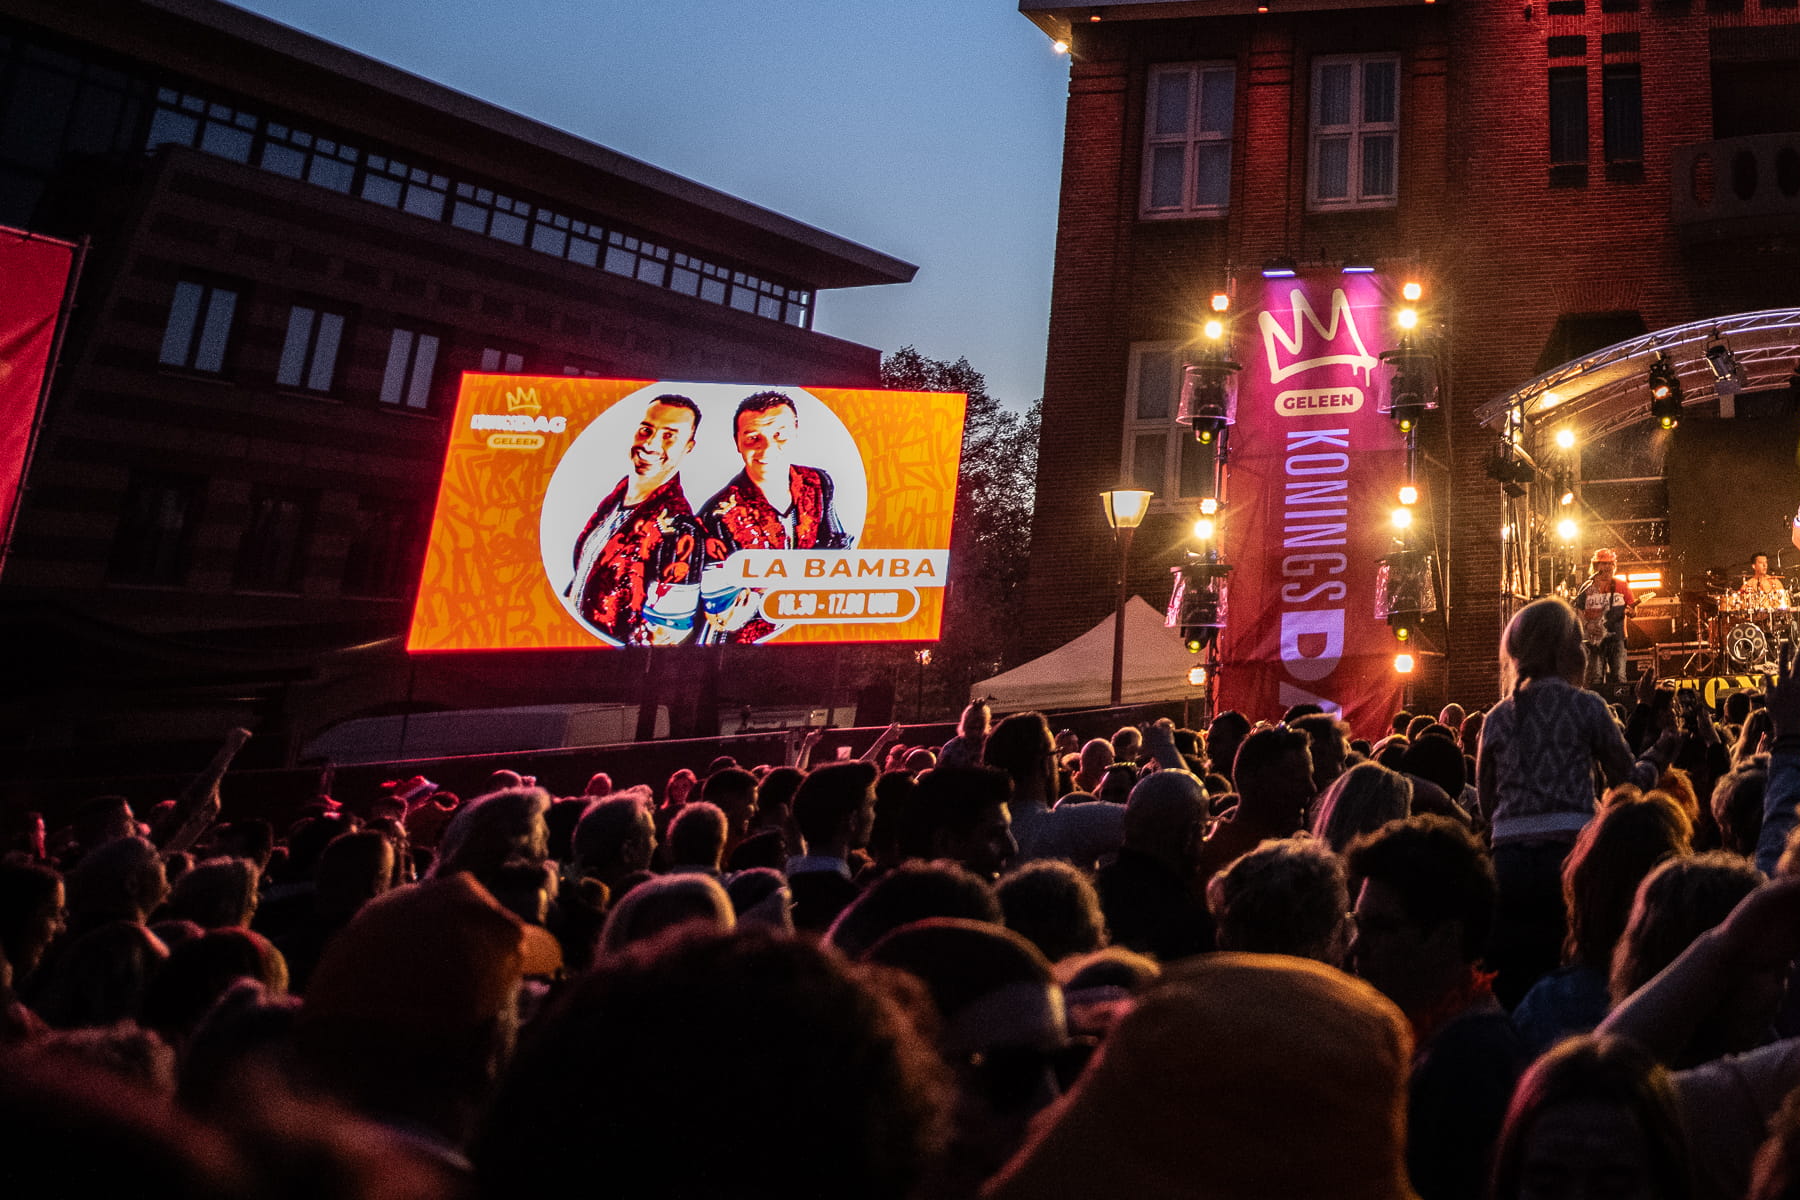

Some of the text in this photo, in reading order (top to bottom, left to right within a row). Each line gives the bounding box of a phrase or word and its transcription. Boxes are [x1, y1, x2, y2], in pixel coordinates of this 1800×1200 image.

[1283, 393, 1354, 410] GELEEN
[742, 558, 936, 578] LA BAMBA
